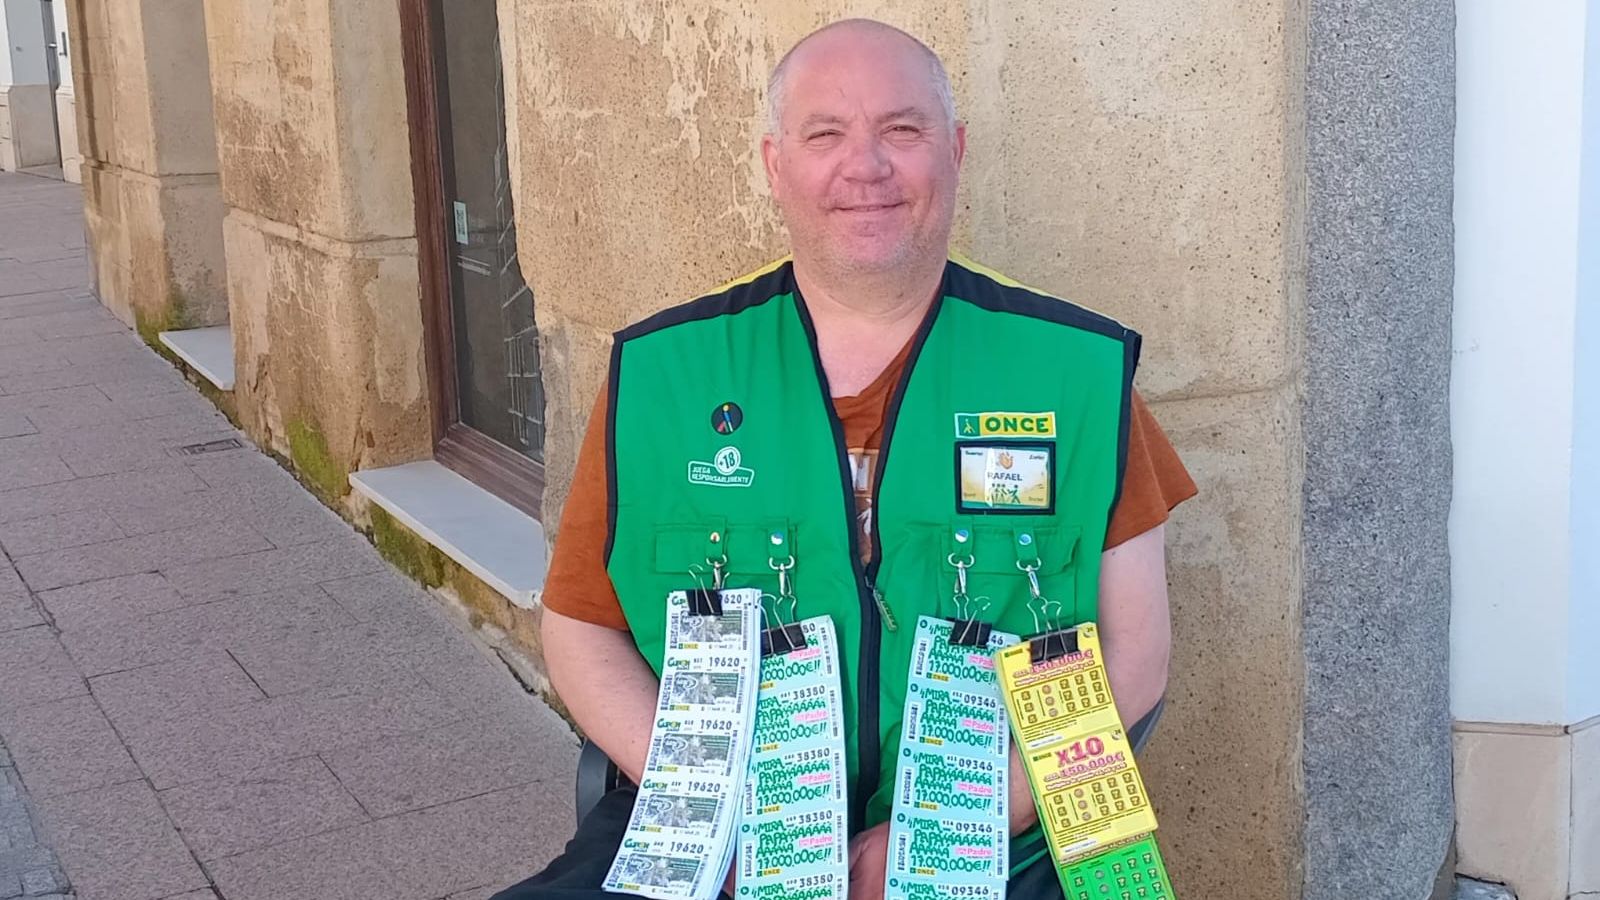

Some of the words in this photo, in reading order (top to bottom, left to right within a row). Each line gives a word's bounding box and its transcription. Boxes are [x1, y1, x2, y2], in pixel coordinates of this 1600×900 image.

[985, 417, 1049, 433] ONCE
[987, 472, 1023, 481] RAFAEL
[709, 656, 740, 667] 19620
[793, 685, 825, 701] 38380
[964, 694, 996, 708] 09346
[700, 719, 732, 730] 19620
[797, 747, 830, 762] 38380
[959, 758, 993, 771] 09346
[688, 781, 721, 792] 19620
[799, 810, 832, 825] 38380
[956, 822, 993, 833] 09346
[670, 841, 704, 854] 19620
[799, 873, 834, 888] 38380
[951, 886, 989, 896] 09346
